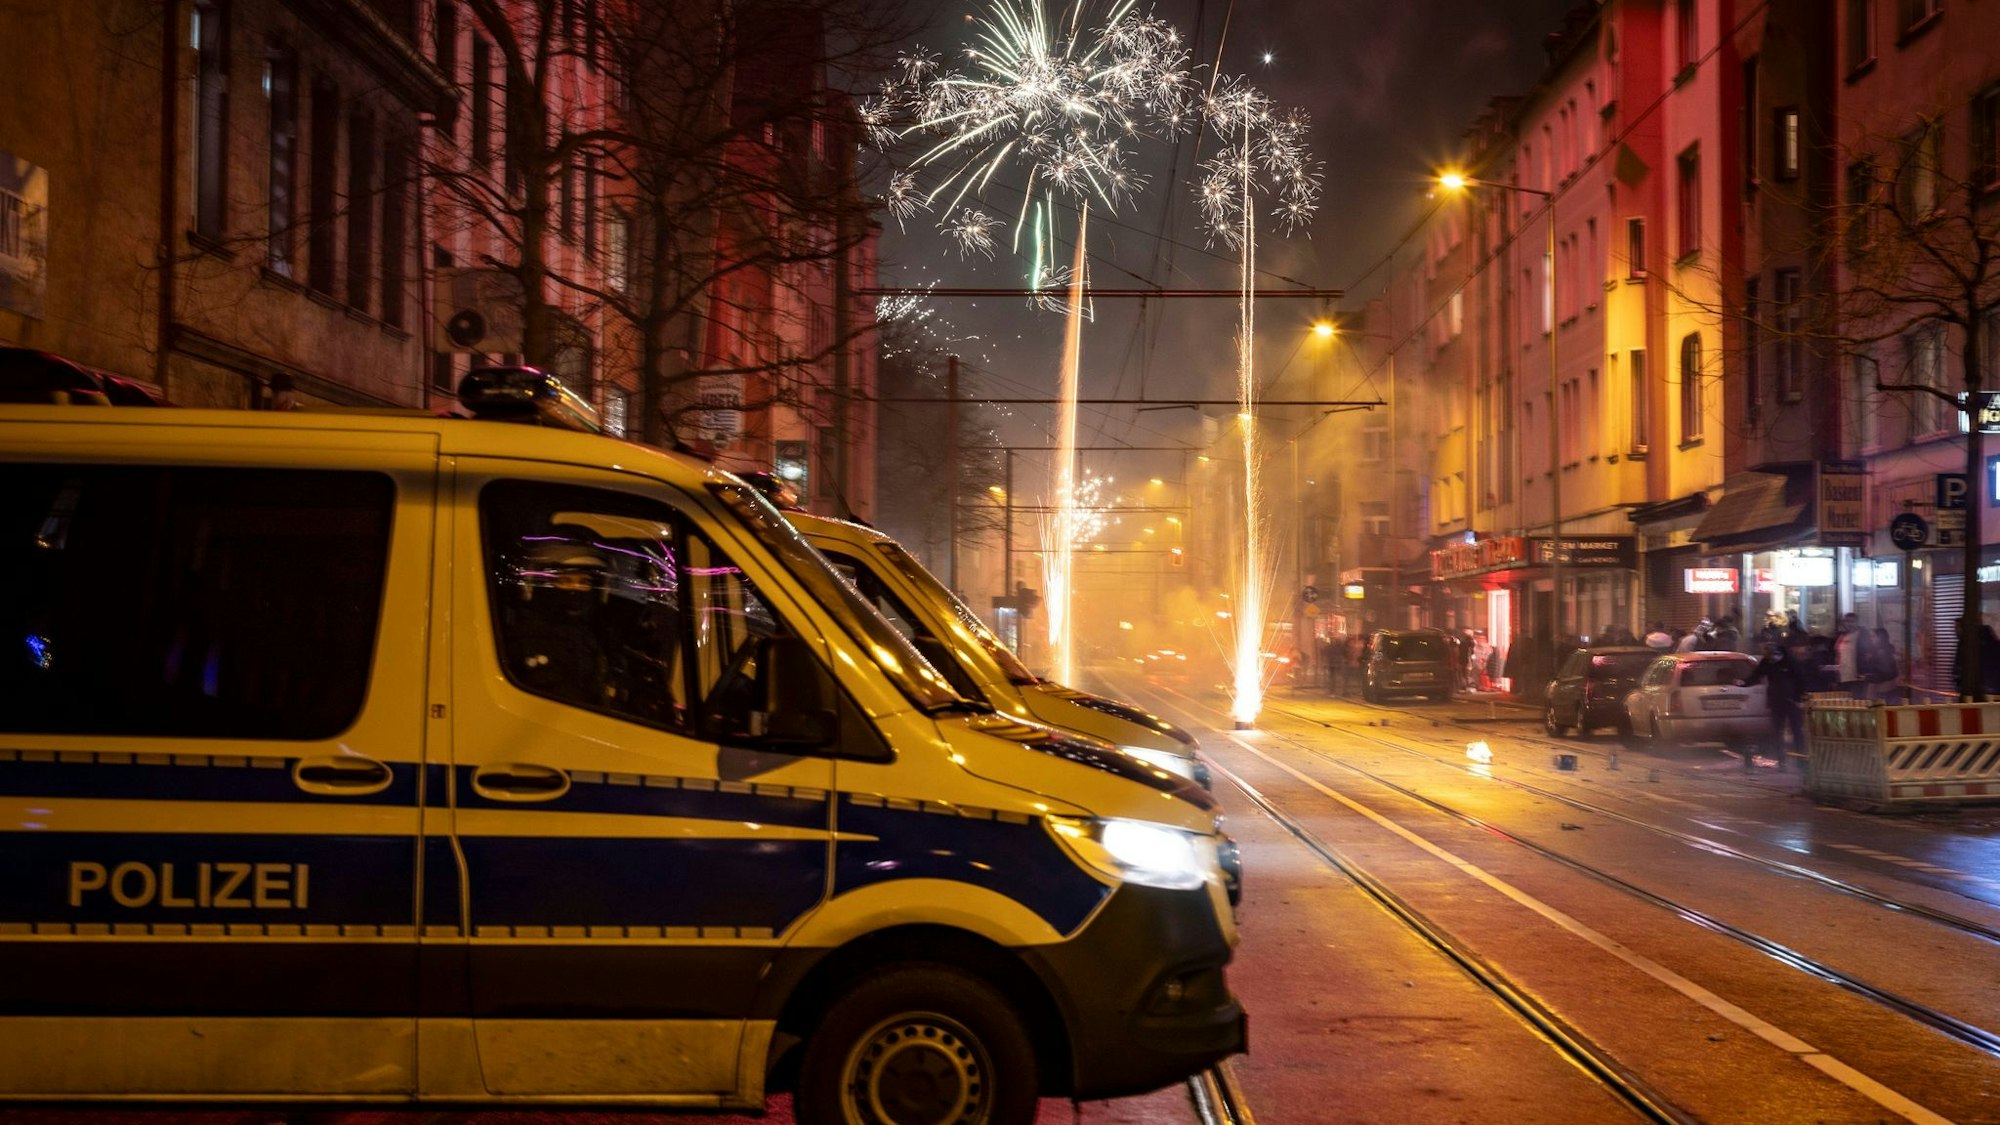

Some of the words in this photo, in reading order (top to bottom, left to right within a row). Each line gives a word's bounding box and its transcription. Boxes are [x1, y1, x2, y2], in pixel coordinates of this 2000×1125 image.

[1944, 477, 1968, 507] P
[1579, 541, 1619, 550] MARKET
[70, 861, 309, 908] POLIZEI
